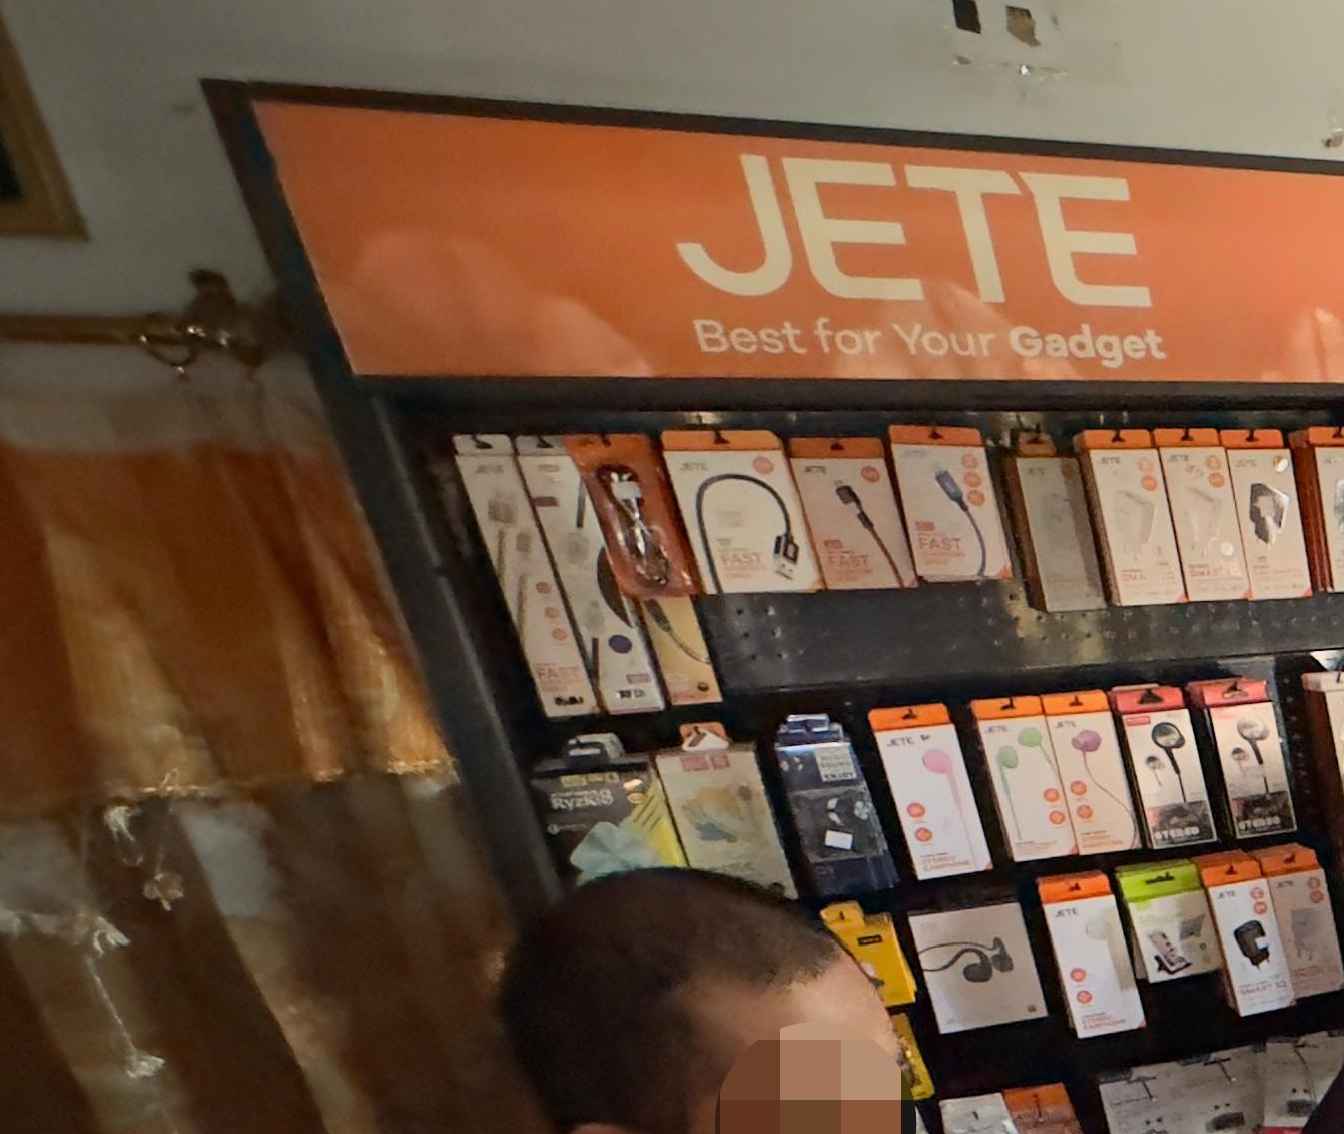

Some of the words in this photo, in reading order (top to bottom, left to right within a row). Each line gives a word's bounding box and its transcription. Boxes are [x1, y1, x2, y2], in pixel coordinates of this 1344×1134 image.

[676, 153, 1152, 308] JETE
[692, 319, 807, 354] Best
[813, 318, 883, 355] for
[894, 323, 996, 358] Your
[1008, 324, 1168, 369] Gadget
[919, 537, 961, 550] FAST
